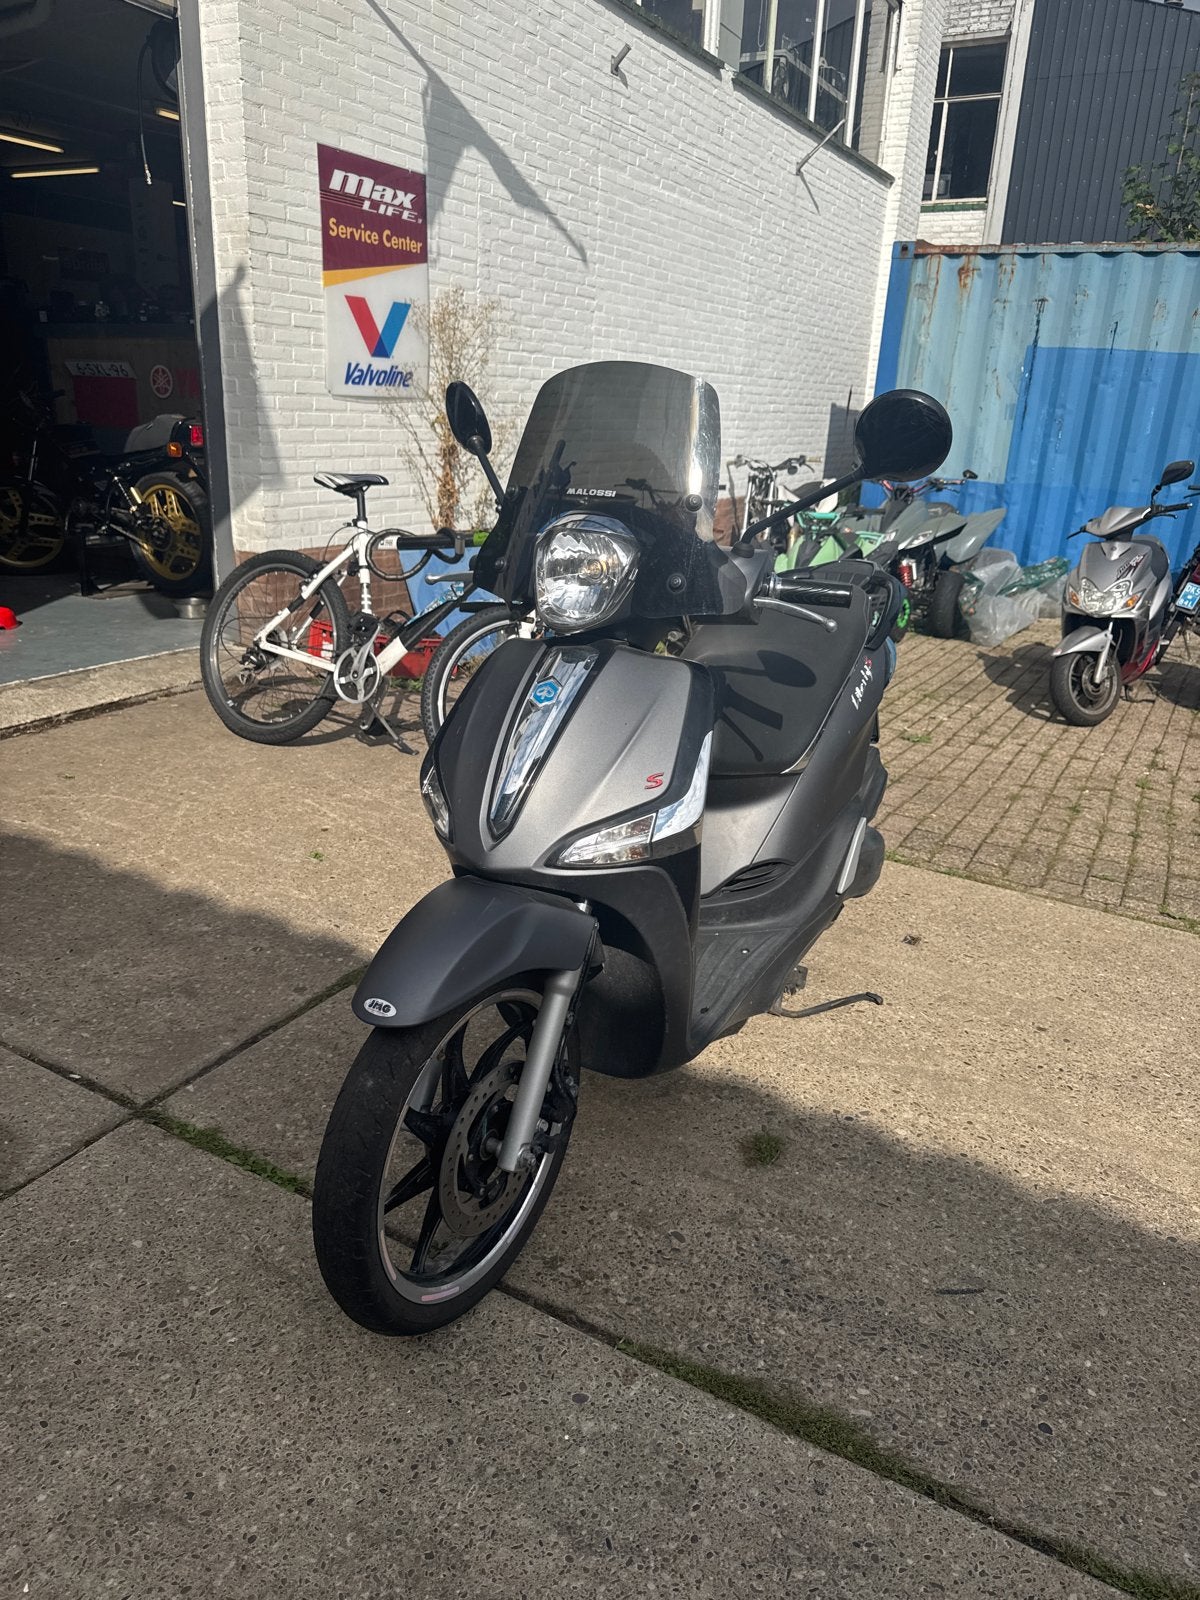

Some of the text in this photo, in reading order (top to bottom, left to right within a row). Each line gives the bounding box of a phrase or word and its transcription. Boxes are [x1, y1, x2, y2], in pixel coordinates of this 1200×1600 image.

[328, 217, 423, 254] Service Center
[344, 362, 414, 388] Valvoline
[566, 488, 617, 497] MALOSSI
[643, 771, 665, 790] S
[368, 999, 391, 1013] JMG
